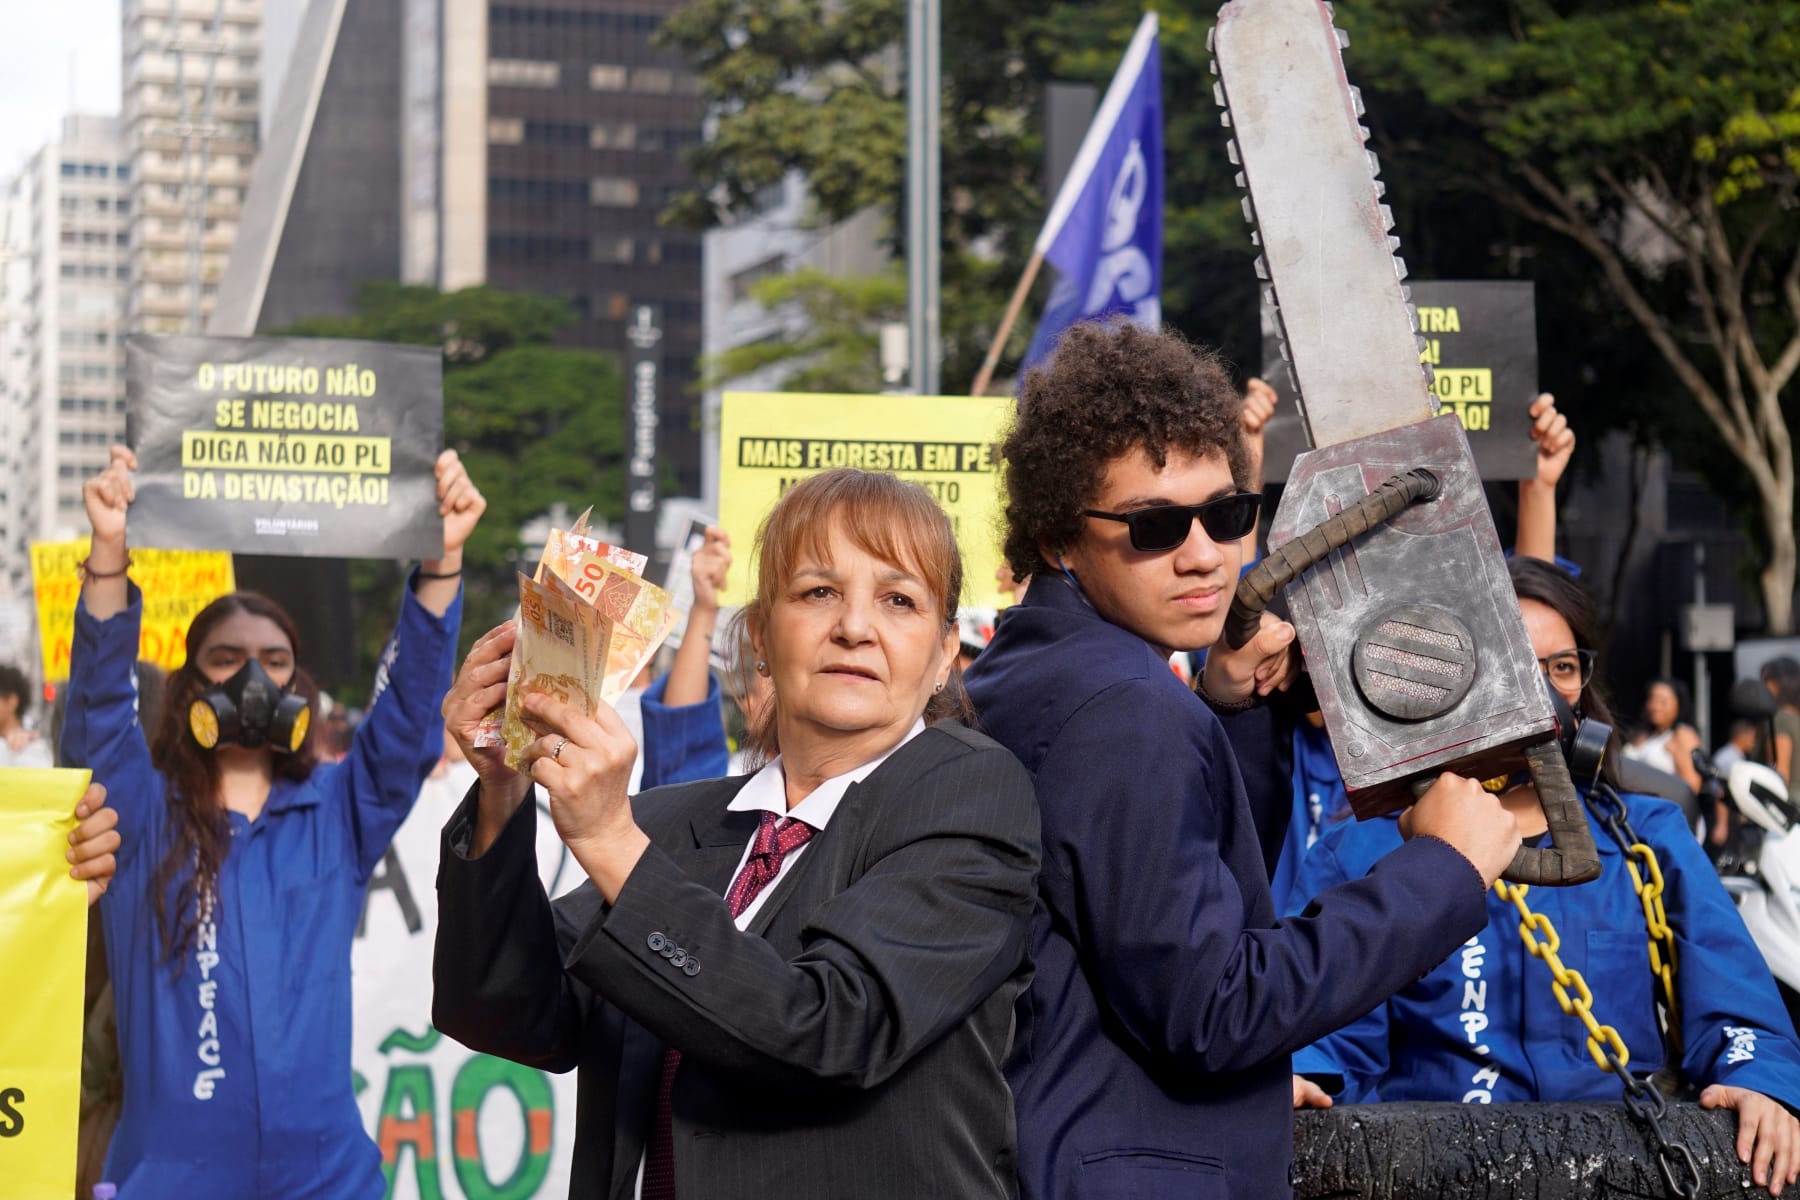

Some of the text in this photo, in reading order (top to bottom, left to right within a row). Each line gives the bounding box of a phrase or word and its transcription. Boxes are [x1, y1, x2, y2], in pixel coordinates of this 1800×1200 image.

[199, 363, 376, 397] O FUTURO NÃO
[1461, 376, 1484, 396] PL
[215, 398, 359, 432] SE NEGOCIA
[191, 434, 382, 467] DIGA NÃO AO PL
[741, 440, 802, 467] MAIS
[807, 441, 918, 471] FLORESTA
[922, 442, 956, 471] EM
[183, 472, 389, 510] DA DEVASTAÇÃO!
[574, 563, 605, 598] 50
[0, 1087, 25, 1138] S
